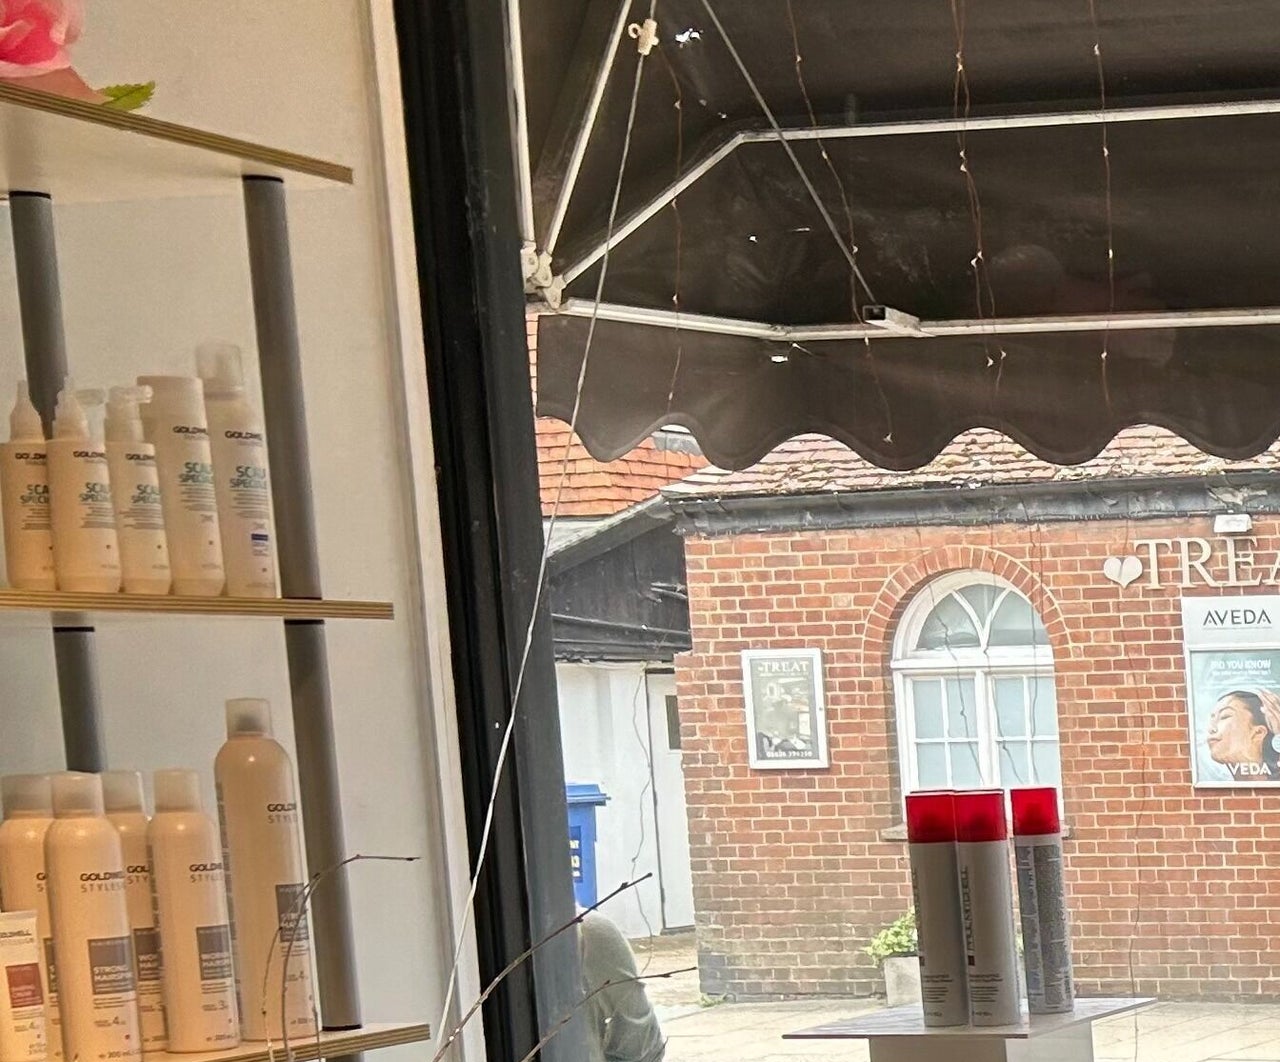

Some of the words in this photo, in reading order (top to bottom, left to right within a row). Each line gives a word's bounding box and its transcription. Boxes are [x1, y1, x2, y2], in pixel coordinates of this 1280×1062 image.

[1202, 608, 1273, 627] AVEDA
[761, 660, 810, 673] TREAT
[1226, 659, 1244, 670] YOU
